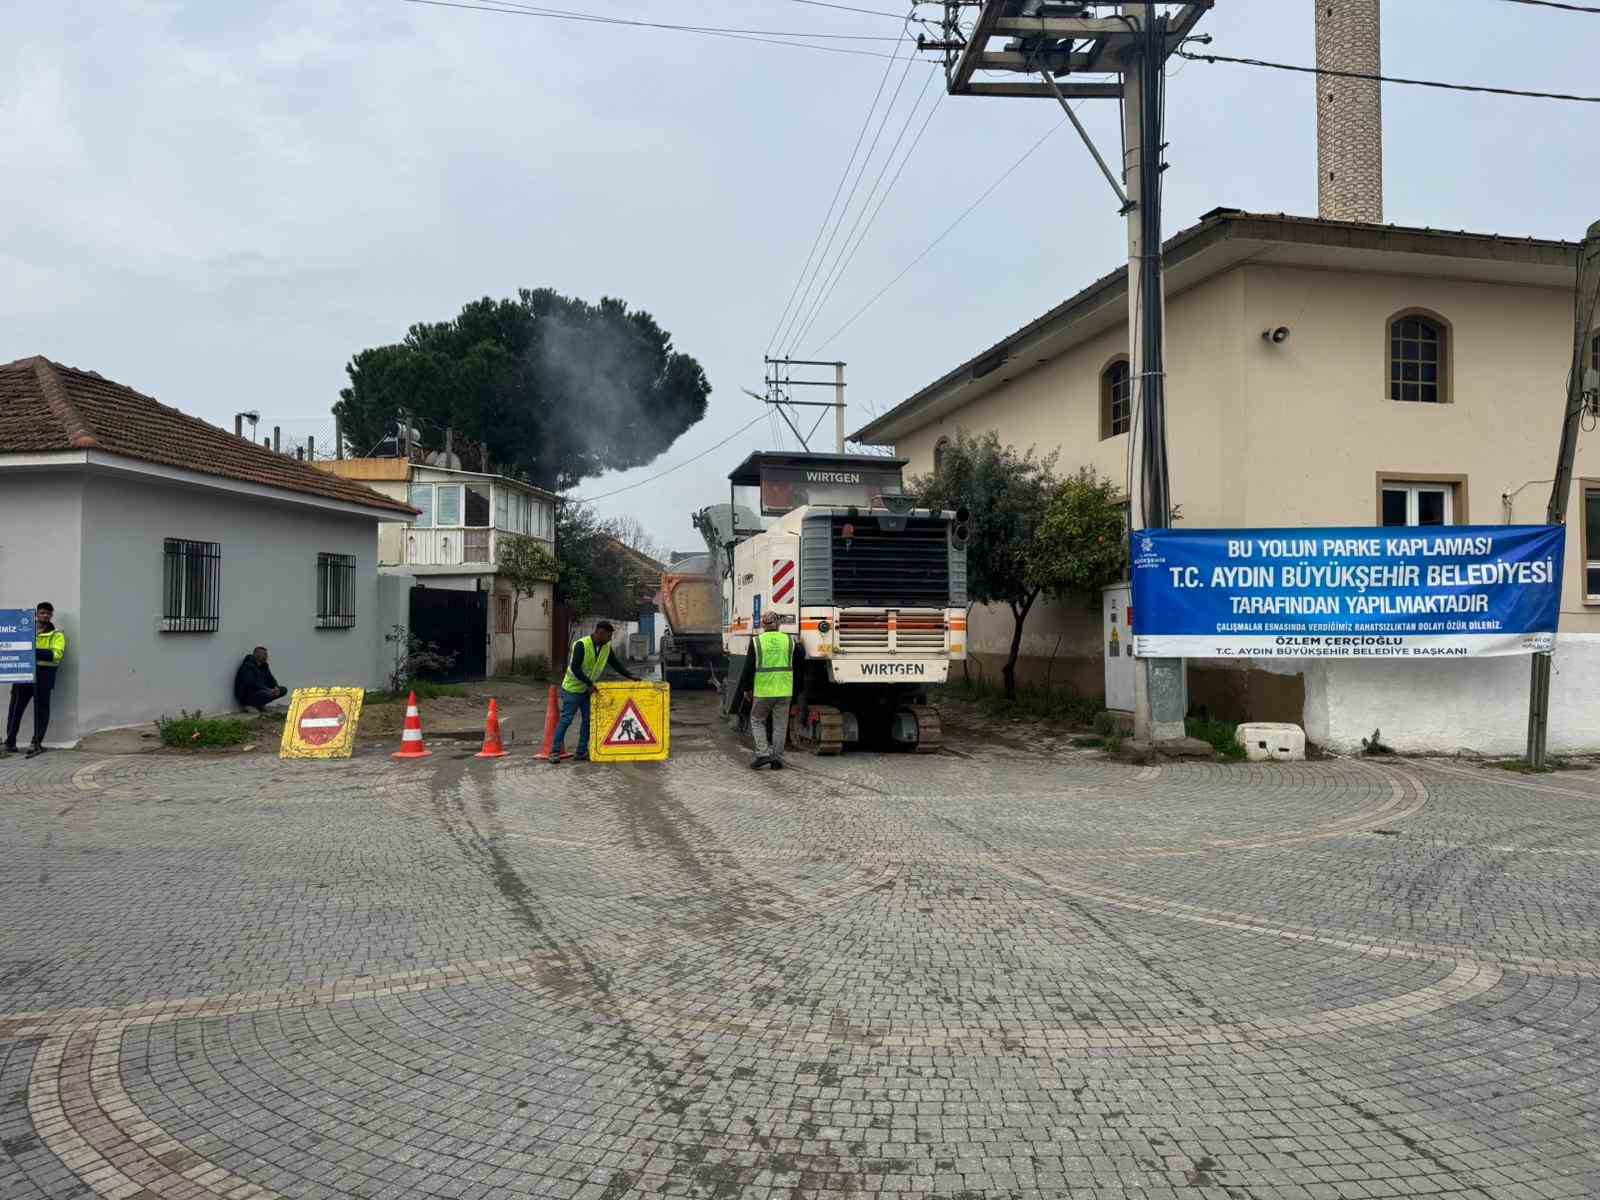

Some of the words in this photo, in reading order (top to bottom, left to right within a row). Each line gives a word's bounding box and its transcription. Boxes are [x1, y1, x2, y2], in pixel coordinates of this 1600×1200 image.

[806, 471, 859, 483] WIRTGEN
[1228, 540, 1252, 557] BU
[1258, 540, 1317, 557] YOLUN
[1324, 540, 1380, 557] PARKE
[1386, 538, 1492, 556] KAPLAMASI
[1169, 567, 1204, 588] T.C.
[1210, 566, 1274, 587] AYDIN
[1282, 562, 1420, 592] BÜYÜKŞEHİR
[1427, 556, 1553, 585] BELEDİYESİ
[1230, 596, 1340, 614] TARAFINDAN
[1345, 594, 1488, 614] YAPILMAKTADIR
[1216, 622, 1262, 632] ÇALIŞMALAR
[1265, 623, 1306, 631] ESNASINDA
[1308, 621, 1352, 631] VERDİĞİMİZ
[1354, 622, 1416, 631] RAHATSIZLIKTAN
[1418, 622, 1444, 631] DOLAYI
[1447, 620, 1467, 630] ÖZÜR
[1276, 636, 1321, 645] ÖZLEM
[1325, 636, 1402, 646] ÇERÇİOĞLU
[1276, 647, 1349, 656] BÜYÜKŞEHİR
[1353, 647, 1409, 655] BELEDİYE
[1413, 648, 1467, 656] BAŞKANI
[861, 663, 924, 675] WIRTGEN
